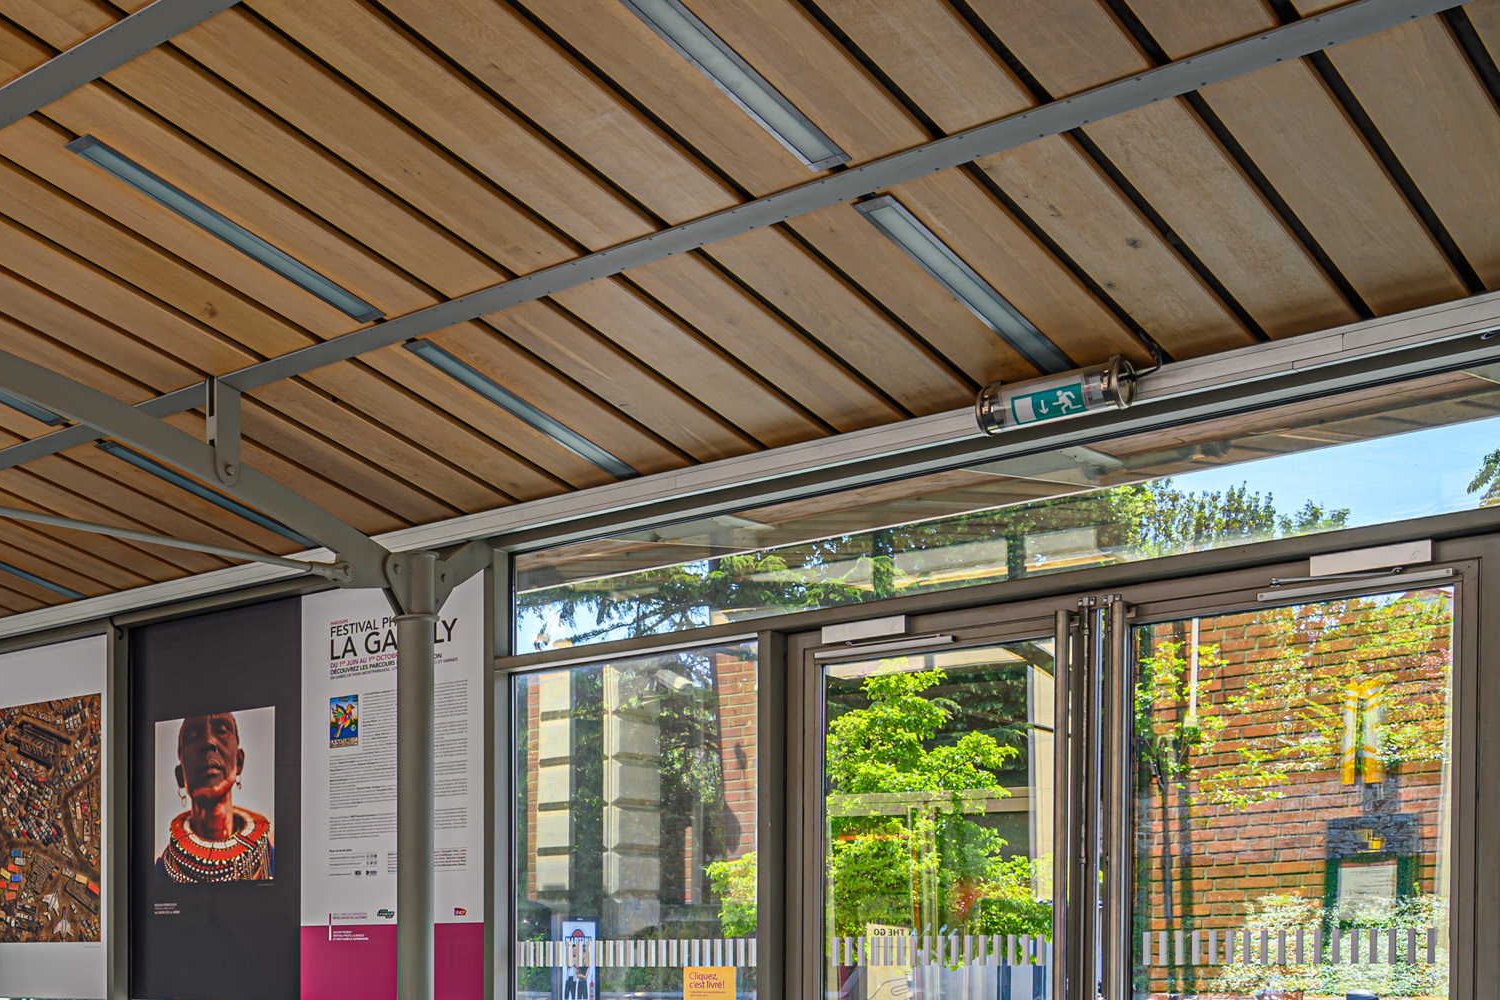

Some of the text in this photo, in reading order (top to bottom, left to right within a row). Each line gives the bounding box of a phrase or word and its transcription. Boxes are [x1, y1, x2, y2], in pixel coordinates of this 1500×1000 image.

[330, 619, 379, 638] FESTIVAL
[331, 636, 358, 660] LA
[376, 653, 397, 661] OCTOB
[370, 660, 396, 669] PARCOURS
[689, 972, 719, 981] Cliquez,
[689, 981, 705, 989] c'est
